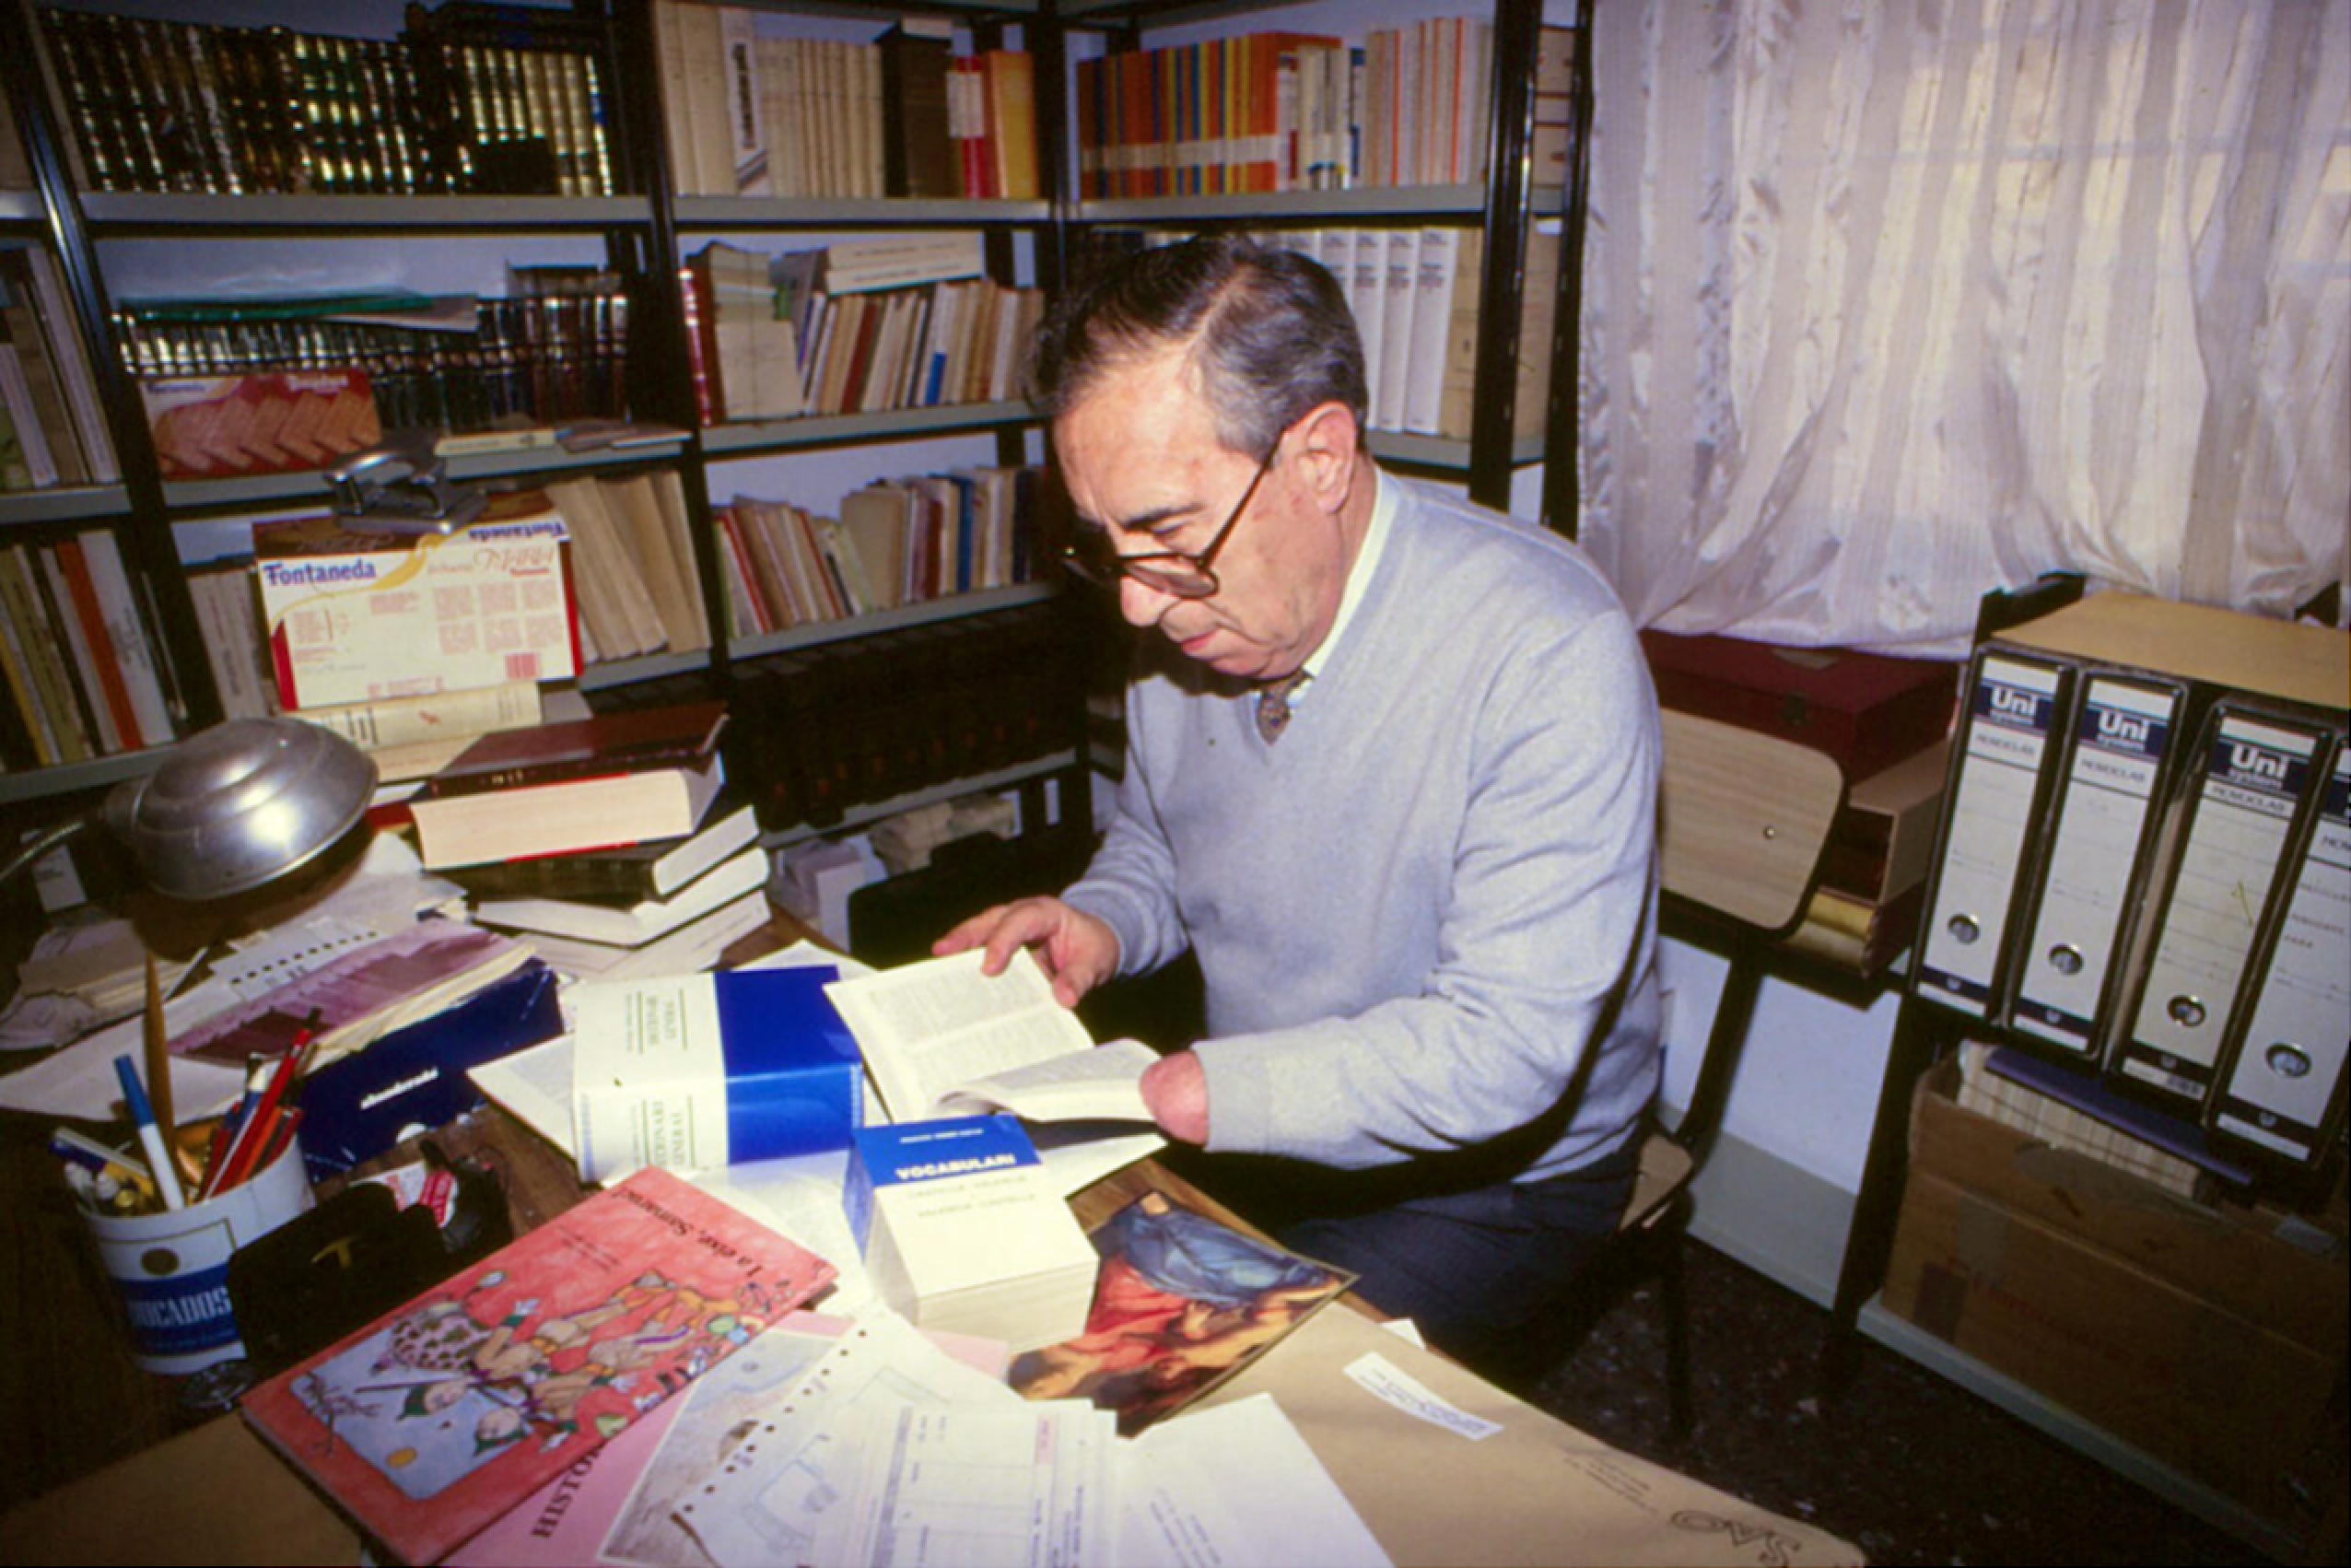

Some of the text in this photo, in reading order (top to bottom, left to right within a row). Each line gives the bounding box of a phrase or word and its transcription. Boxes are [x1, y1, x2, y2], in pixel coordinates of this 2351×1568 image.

[262, 556, 378, 587] Fontaneda
[1991, 685, 2039, 717] Uni
[2098, 708, 2149, 742] Uni
[2230, 743, 2289, 778] Uni
[895, 1153, 1016, 1181] VOCABULARI
